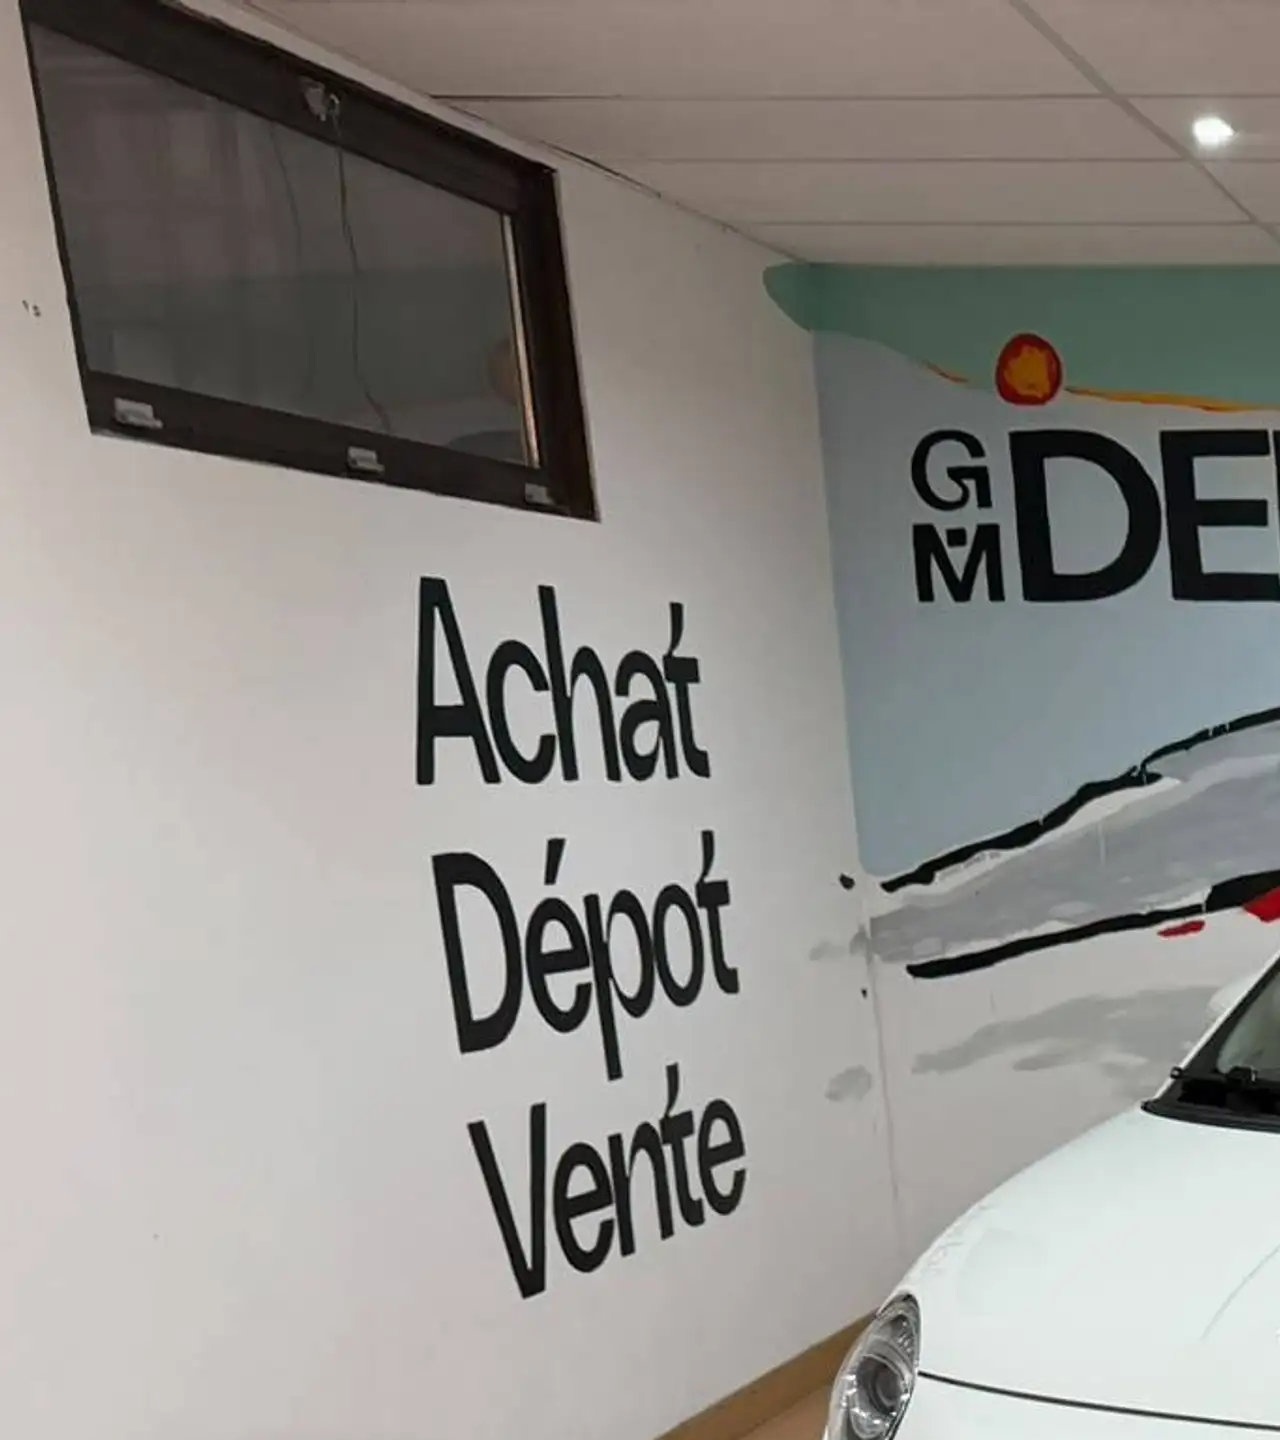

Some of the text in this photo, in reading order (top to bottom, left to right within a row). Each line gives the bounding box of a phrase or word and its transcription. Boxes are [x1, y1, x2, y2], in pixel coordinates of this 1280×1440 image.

[416, 576, 711, 785] Achat
[431, 830, 740, 1082] Dépot
[467, 1062, 747, 1300] Vente
